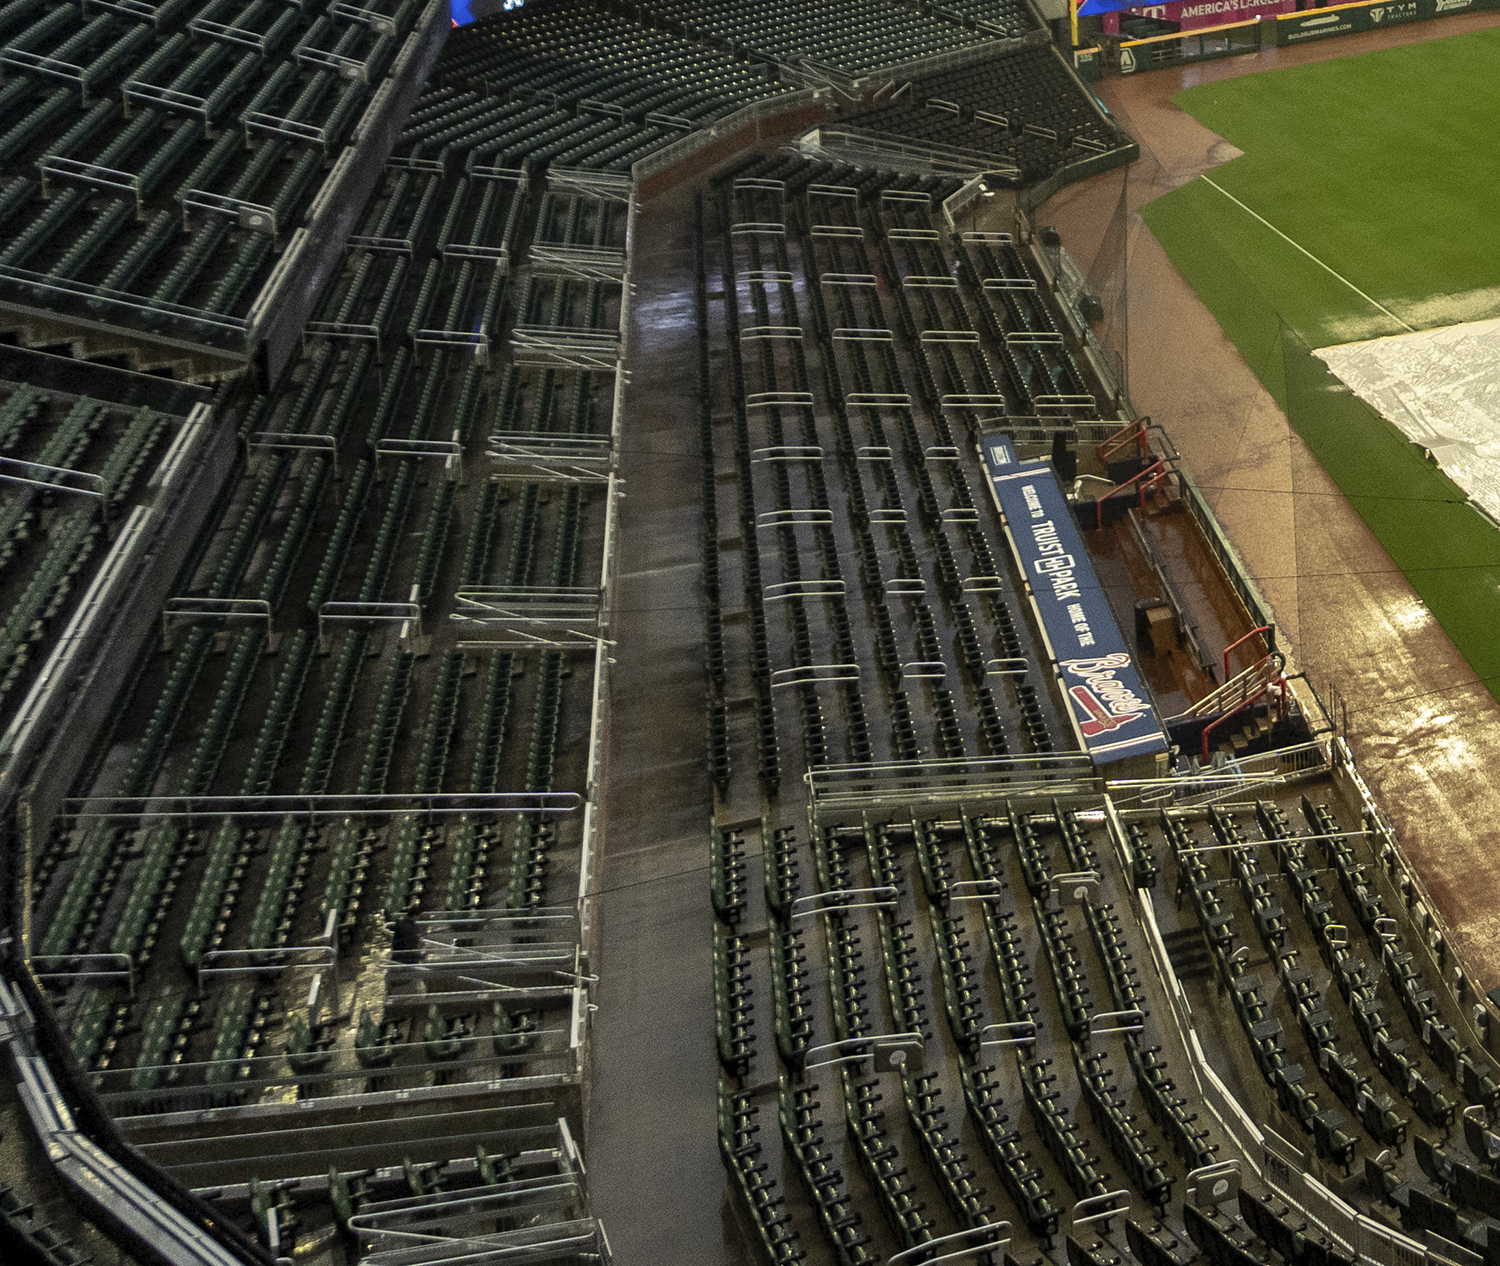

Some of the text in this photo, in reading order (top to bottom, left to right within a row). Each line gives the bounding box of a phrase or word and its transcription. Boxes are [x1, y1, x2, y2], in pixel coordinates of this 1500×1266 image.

[1386, 2, 1417, 13] TYM
[1021, 484, 1152, 714] WELCOME TO TRUIST PARK HOME OF THE Braves
